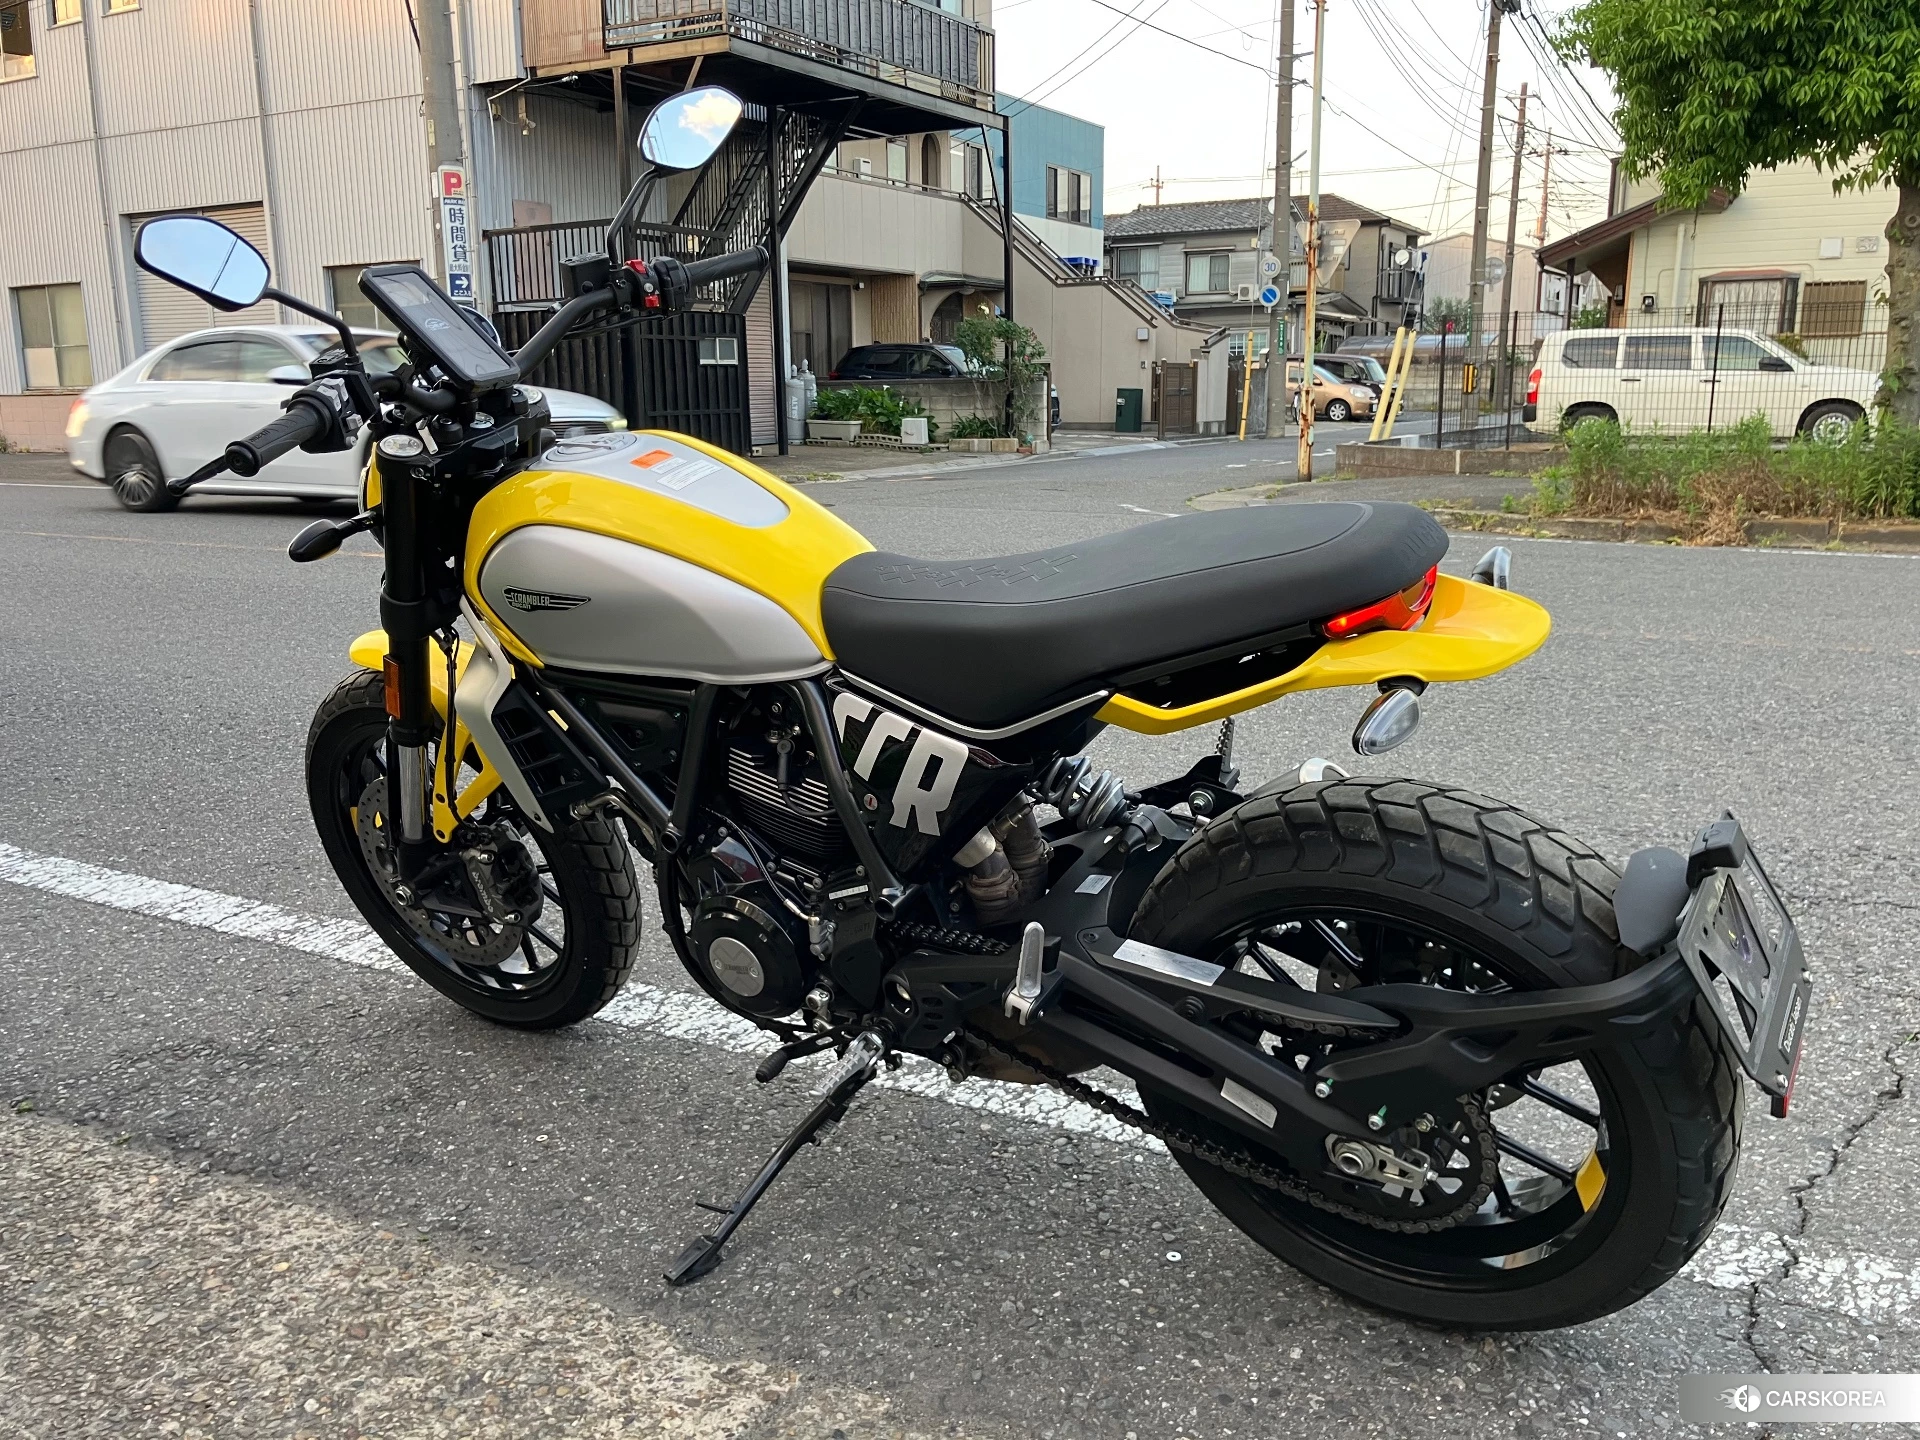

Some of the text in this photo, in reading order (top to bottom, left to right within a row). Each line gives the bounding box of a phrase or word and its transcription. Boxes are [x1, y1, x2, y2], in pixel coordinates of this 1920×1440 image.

[443, 172, 463, 196] P
[448, 207, 468, 262] 時間貸
[1264, 262, 1276, 272] 30
[510, 592, 550, 607] SCRAMBLER
